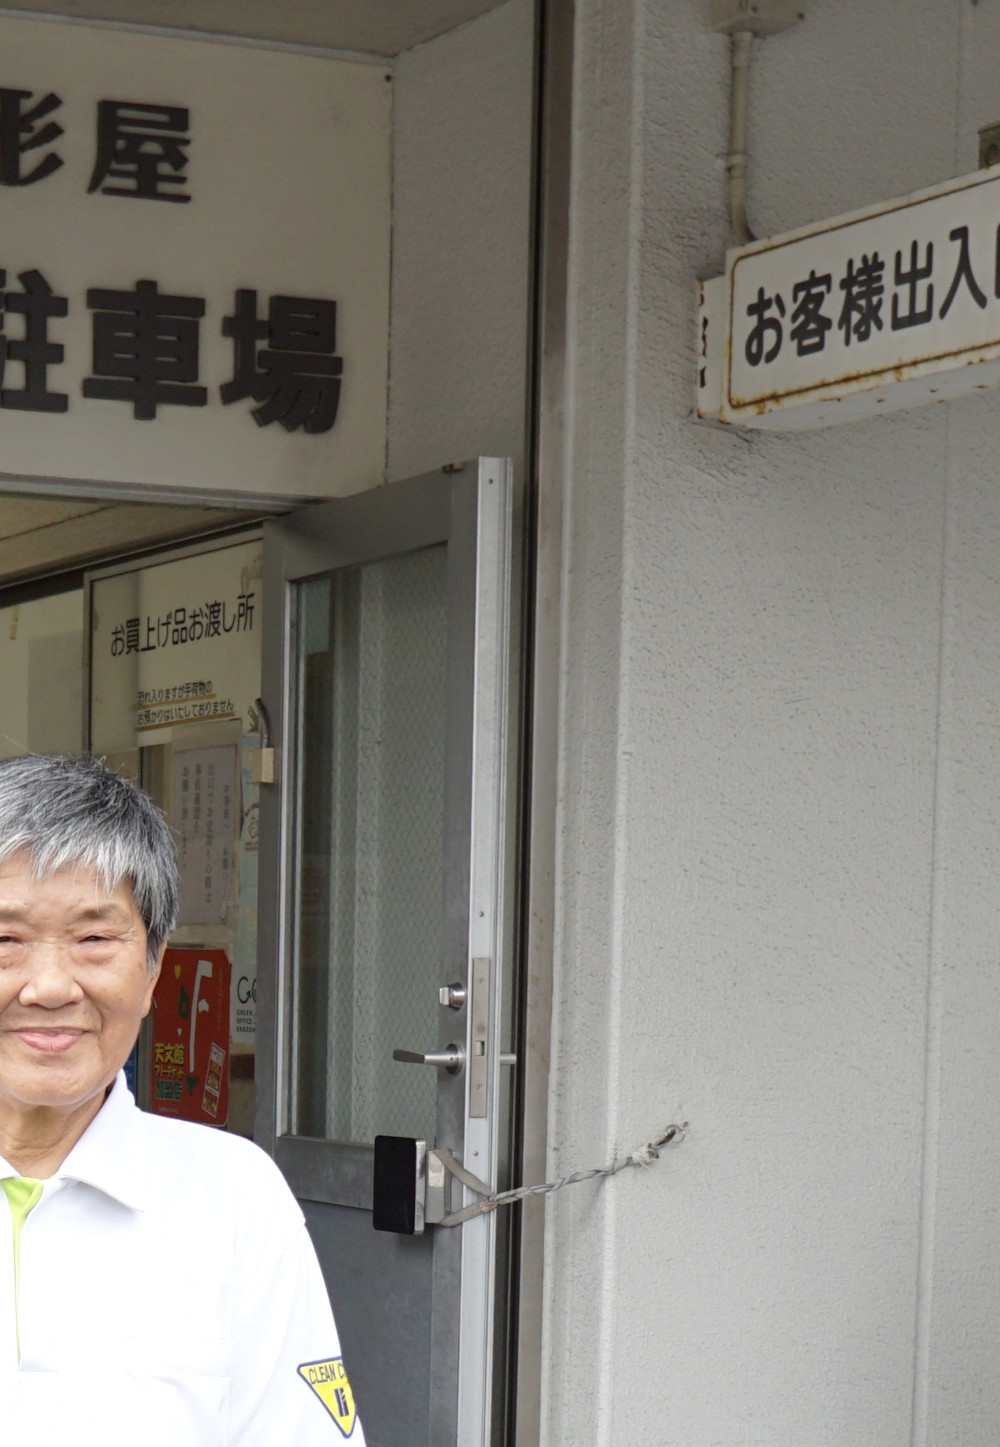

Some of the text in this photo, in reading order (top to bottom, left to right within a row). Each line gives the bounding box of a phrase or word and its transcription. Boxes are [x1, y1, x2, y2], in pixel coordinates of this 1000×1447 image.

[744, 223, 1000, 367] お客様出入
[110, 593, 255, 657] お買上げ品お渡し所
[308, 1364, 337, 1385] CLEAN
